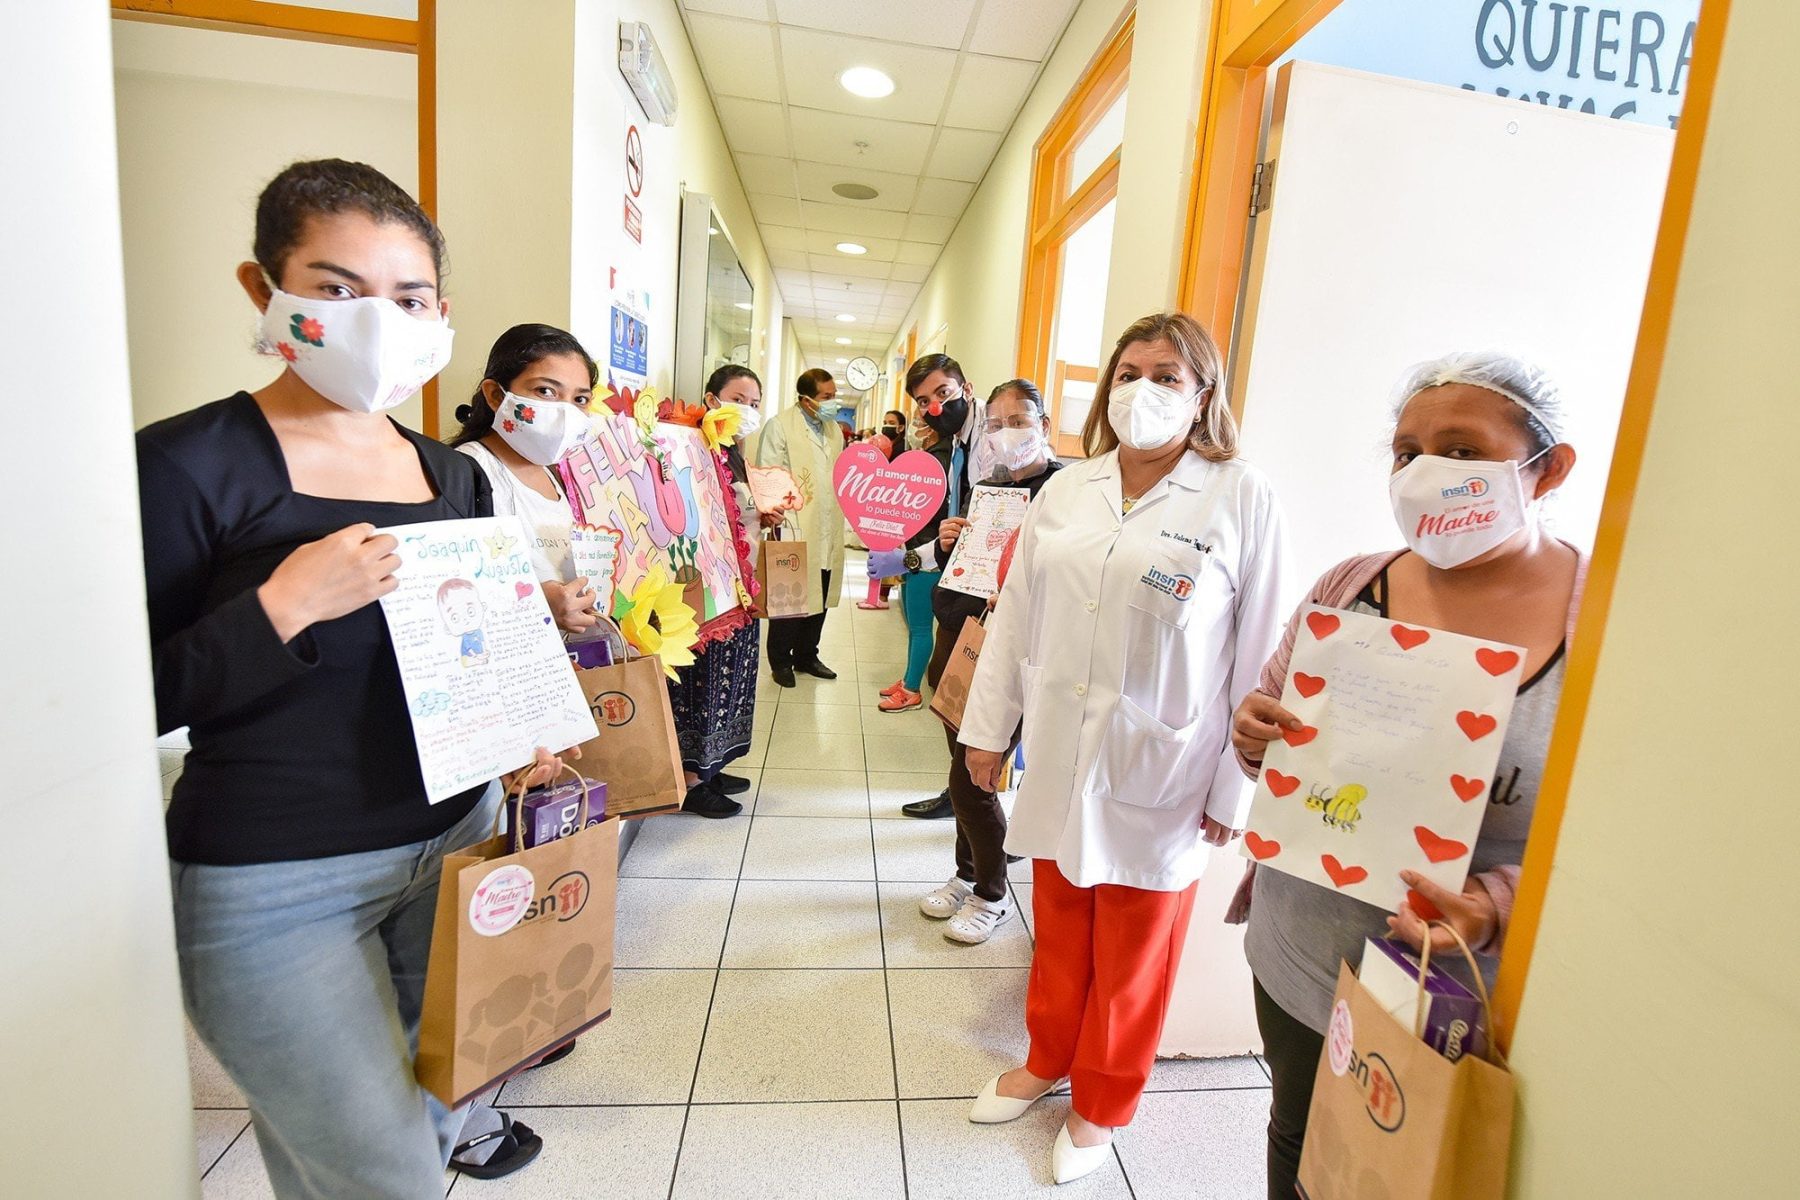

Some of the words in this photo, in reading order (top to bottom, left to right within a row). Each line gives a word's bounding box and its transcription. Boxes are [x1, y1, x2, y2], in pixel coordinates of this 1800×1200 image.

[568, 411, 647, 508] FELIZ
[837, 464, 933, 510] Madre
[876, 468, 884, 477] El
[884, 470, 910, 480] amor
[911, 472, 922, 483] de
[923, 477, 942, 486] una
[1441, 485, 1469, 498] insn
[865, 503, 873, 513] lo
[874, 506, 901, 517] puede
[901, 509, 921, 521] todo
[1416, 510, 1500, 538] Madre
[776, 557, 791, 567] insn
[1148, 565, 1177, 588] insn
